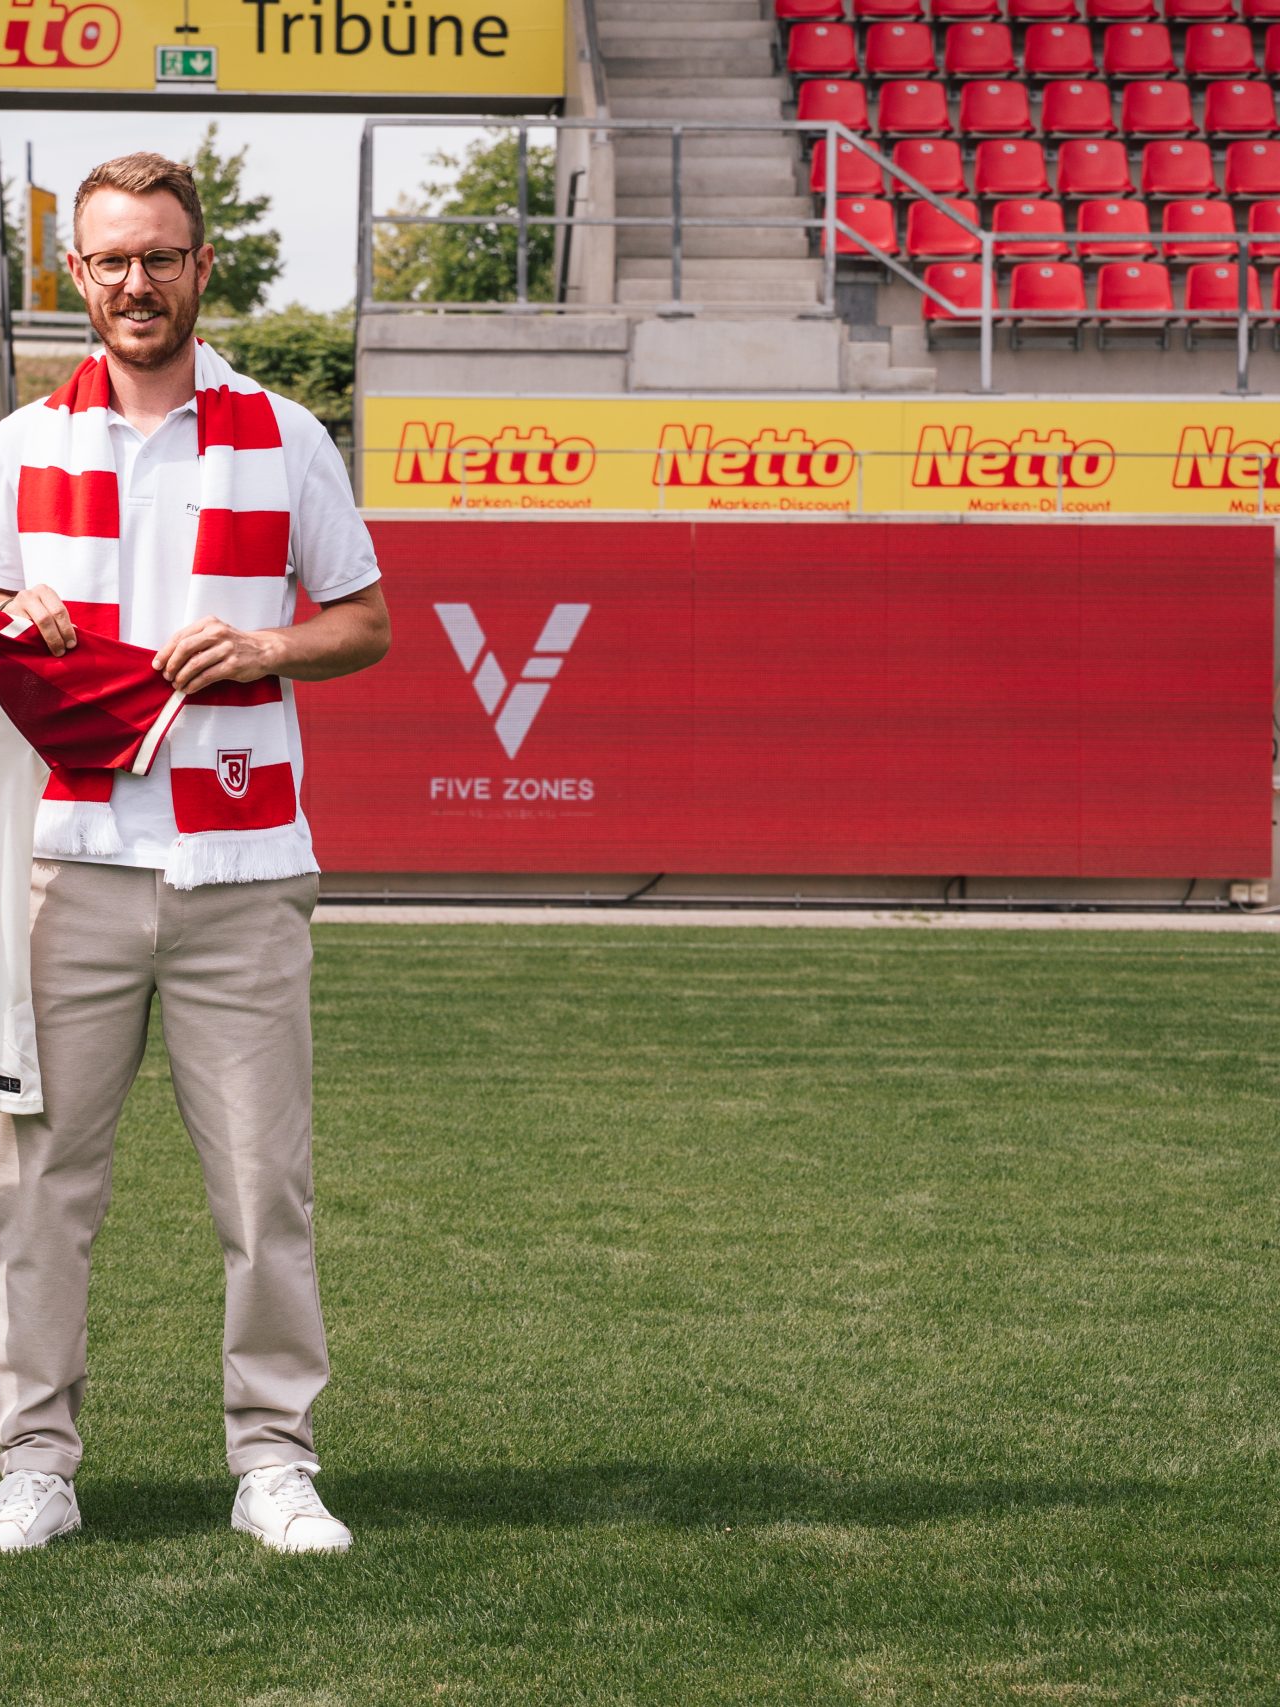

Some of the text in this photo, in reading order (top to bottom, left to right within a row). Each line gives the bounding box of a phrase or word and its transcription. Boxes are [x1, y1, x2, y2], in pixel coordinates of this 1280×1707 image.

[242, 0, 509, 58] Tribüne
[394, 421, 596, 485] Netto
[652, 424, 855, 487] Netto
[911, 425, 1116, 489] Netto
[708, 497, 851, 511] Marken-Discount
[431, 778, 594, 800] FIVE ZONES
